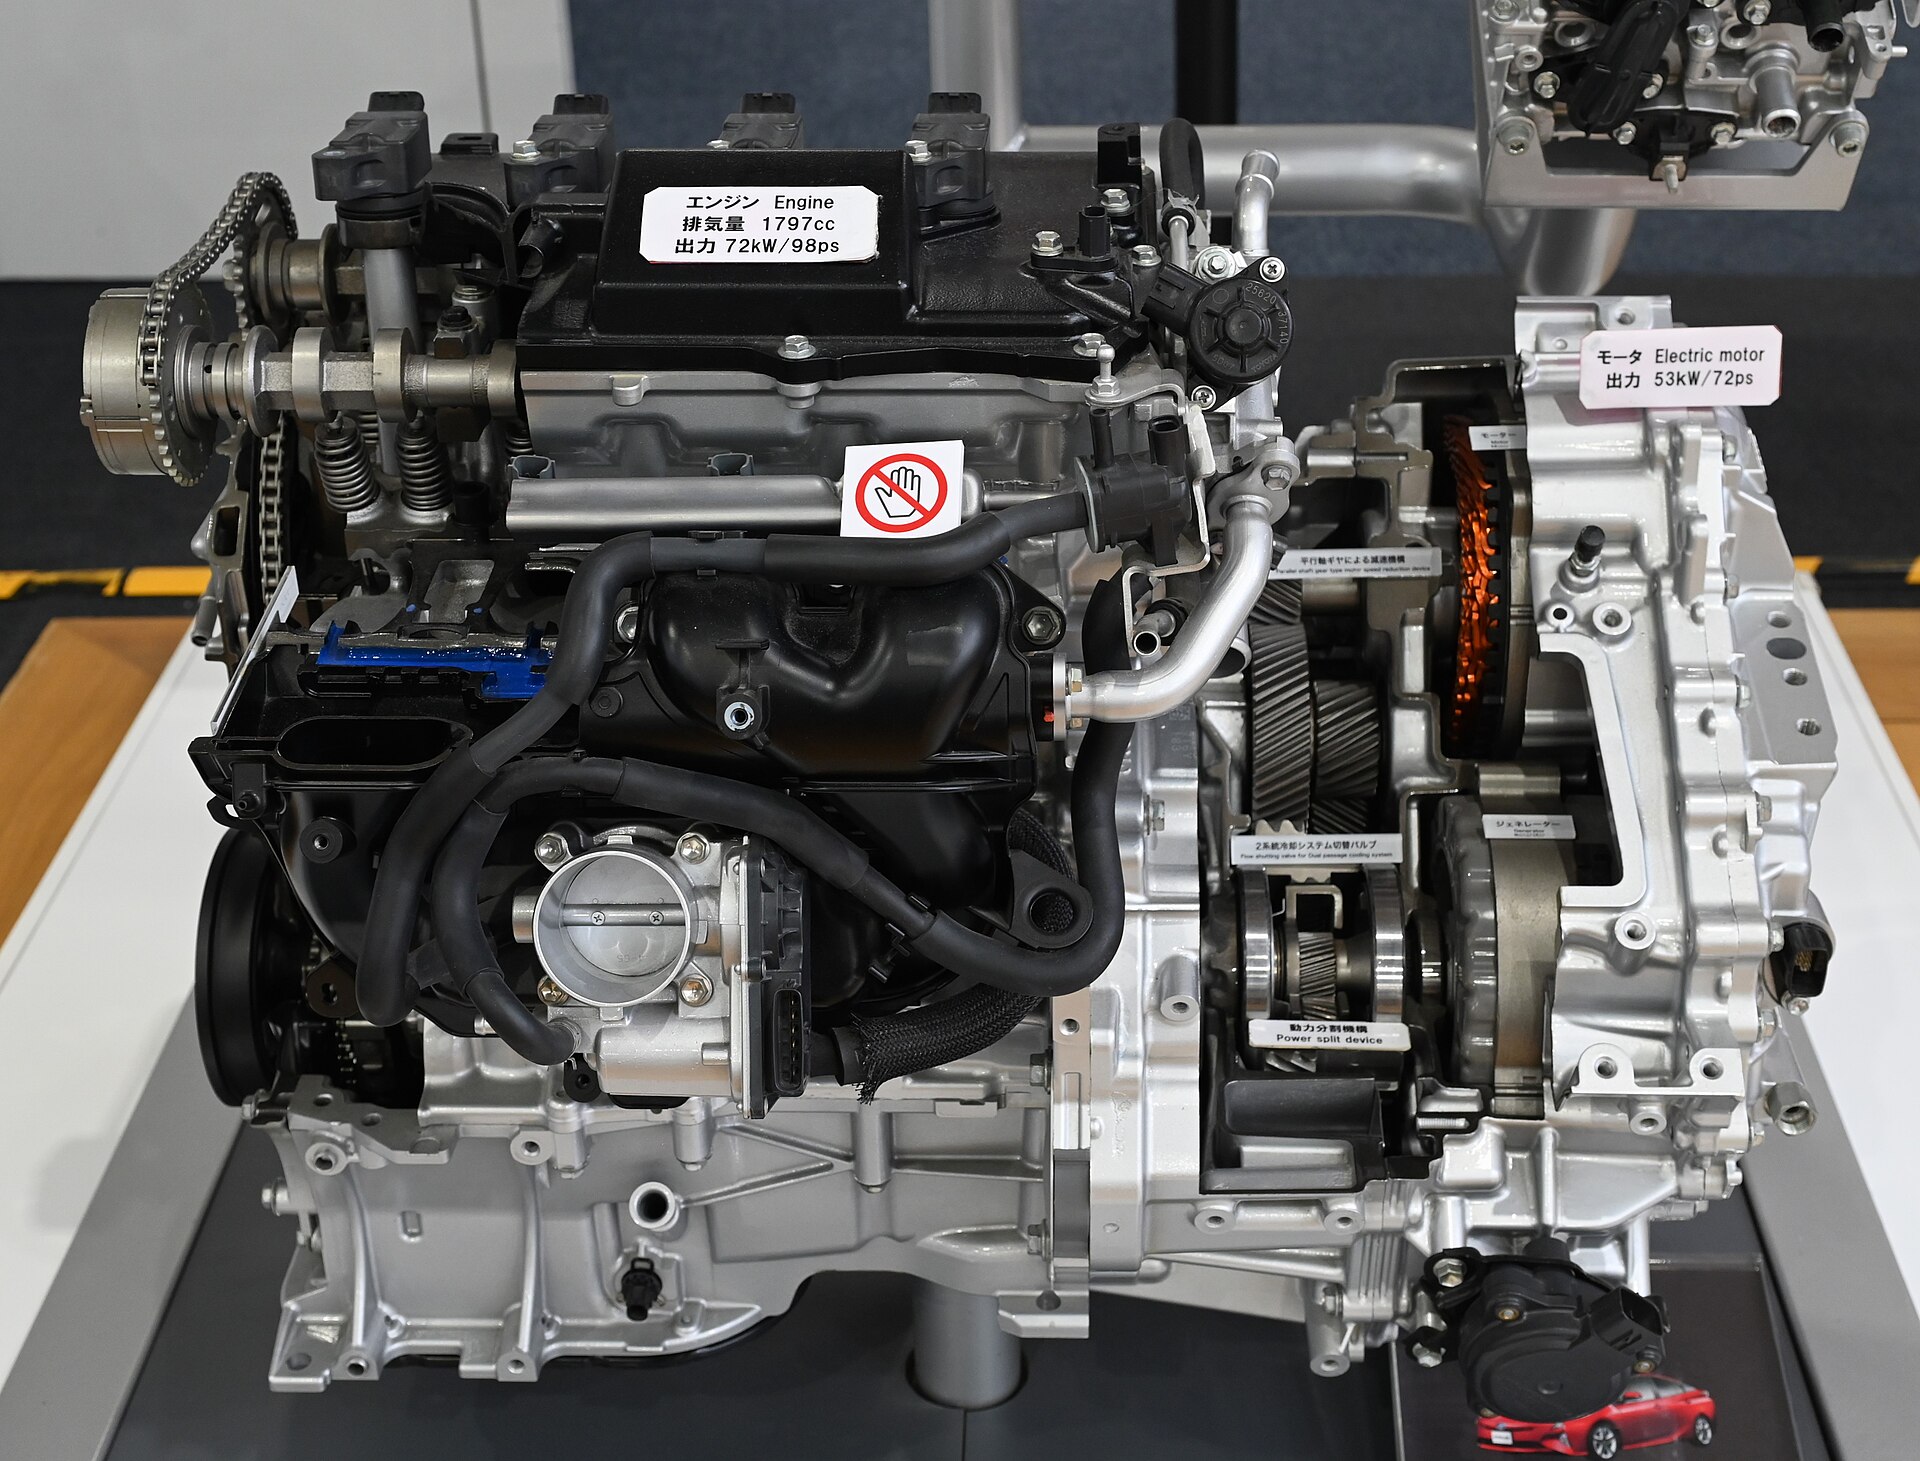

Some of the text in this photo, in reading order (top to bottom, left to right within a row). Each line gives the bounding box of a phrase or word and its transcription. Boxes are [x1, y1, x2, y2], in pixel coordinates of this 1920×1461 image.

[686, 195, 835, 211] エンジン Engine
[682, 216, 836, 232] 排気量 1797cc
[674, 237, 840, 255] 出力 72kW/98ps
[1245, 282, 1278, 305] 25620
[1277, 311, 1289, 344] 37140
[1597, 347, 1766, 365] モータ Electric motor
[1606, 369, 1754, 389] 出力 53kW/72ps
[1289, 1023, 1368, 1034] 動力分割機構
[1276, 1034, 1383, 1045] Power split device
